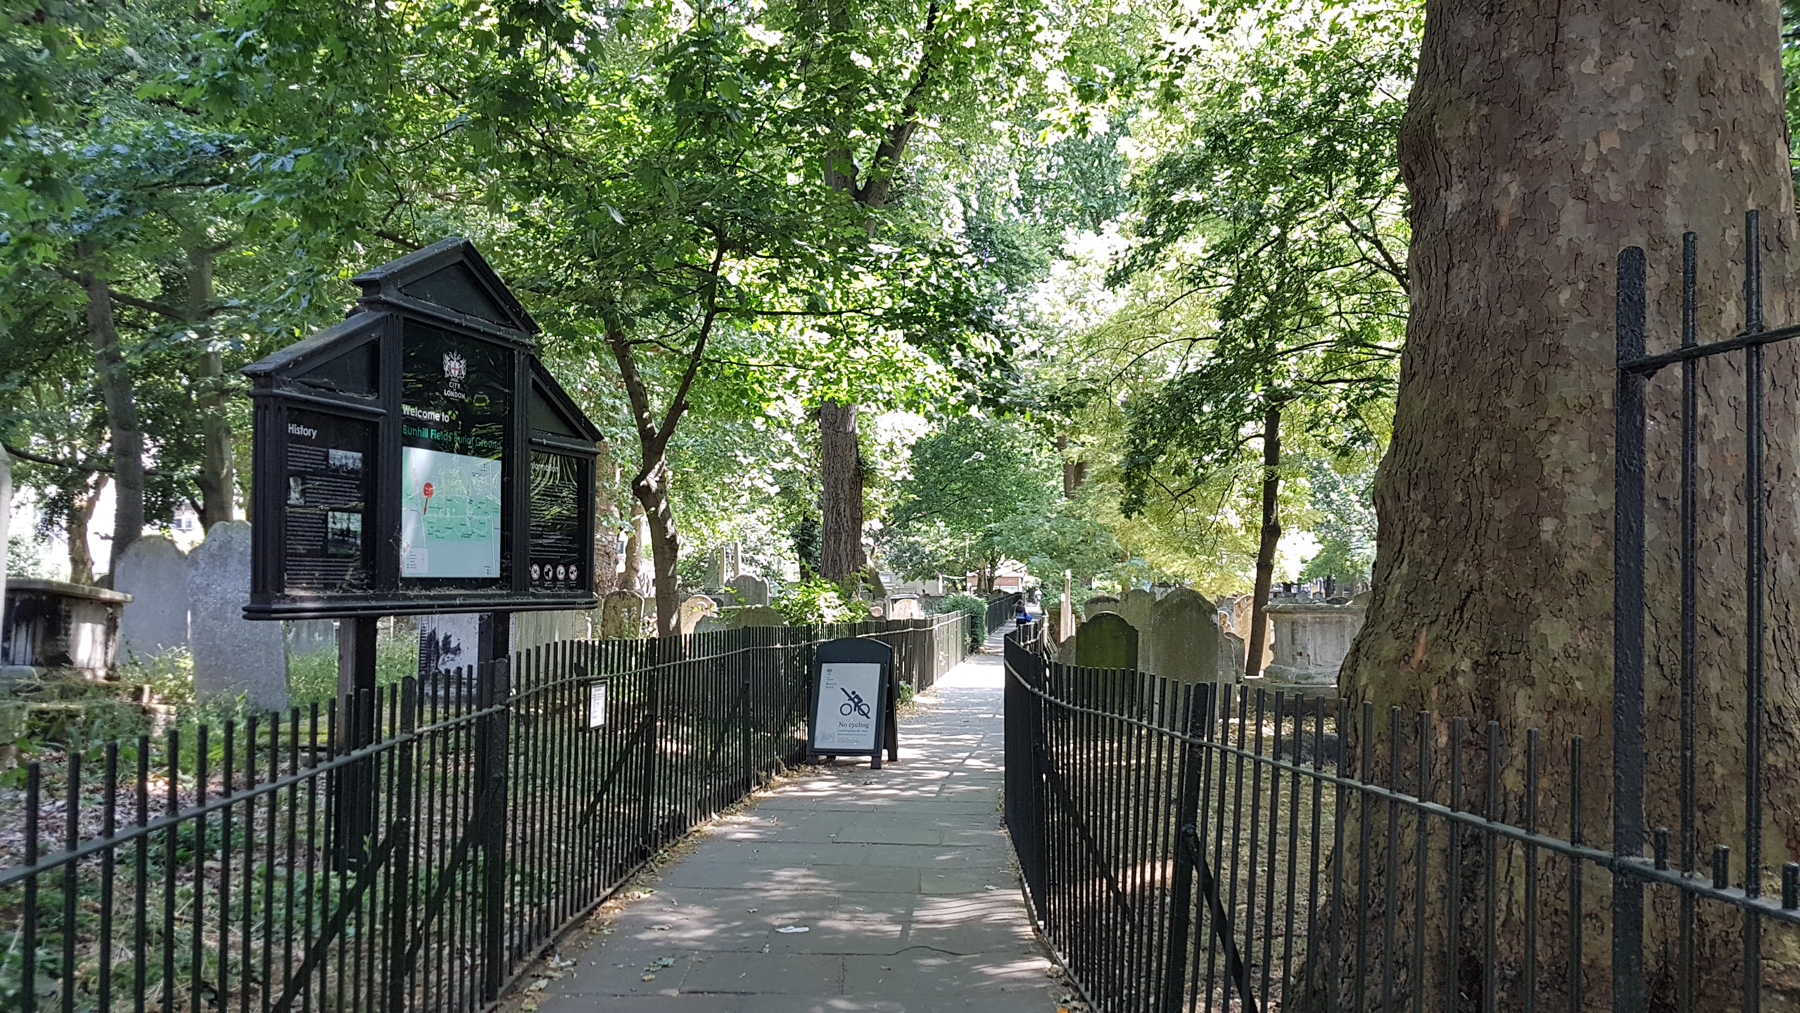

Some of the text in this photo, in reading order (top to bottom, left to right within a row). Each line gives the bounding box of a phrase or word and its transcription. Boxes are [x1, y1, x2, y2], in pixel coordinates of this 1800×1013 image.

[448, 381, 461, 389] CITY
[443, 389, 466, 399] LONDON
[401, 404, 450, 422] Welcome to
[287, 423, 317, 439] History
[402, 425, 503, 450] Bunhill Fields Burial Ground
[848, 721, 870, 729] cycling
